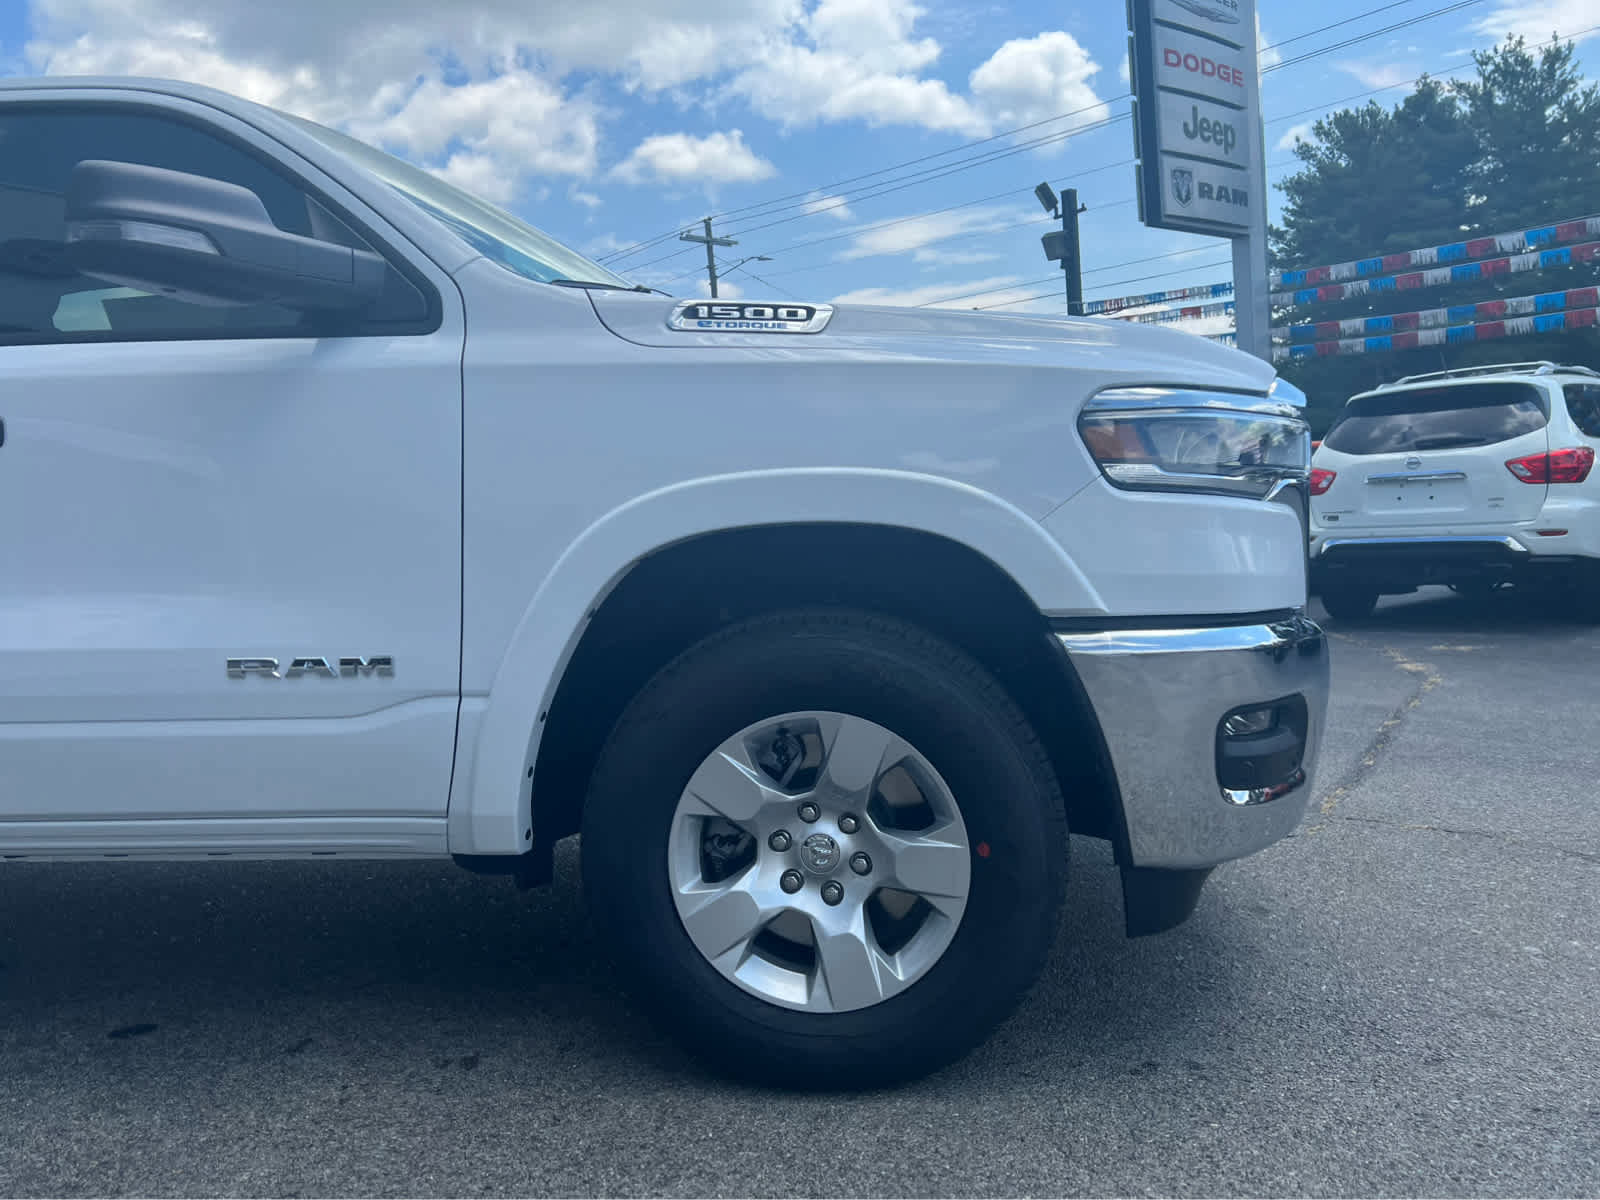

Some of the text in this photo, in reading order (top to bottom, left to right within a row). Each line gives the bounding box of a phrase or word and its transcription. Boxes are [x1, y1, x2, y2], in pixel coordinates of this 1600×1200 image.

[1163, 47, 1245, 88] DODGE
[1183, 104, 1236, 155] Jeep
[1198, 182, 1249, 208] RAM
[696, 305, 808, 320] 1500
[226, 656, 395, 680] RAM
